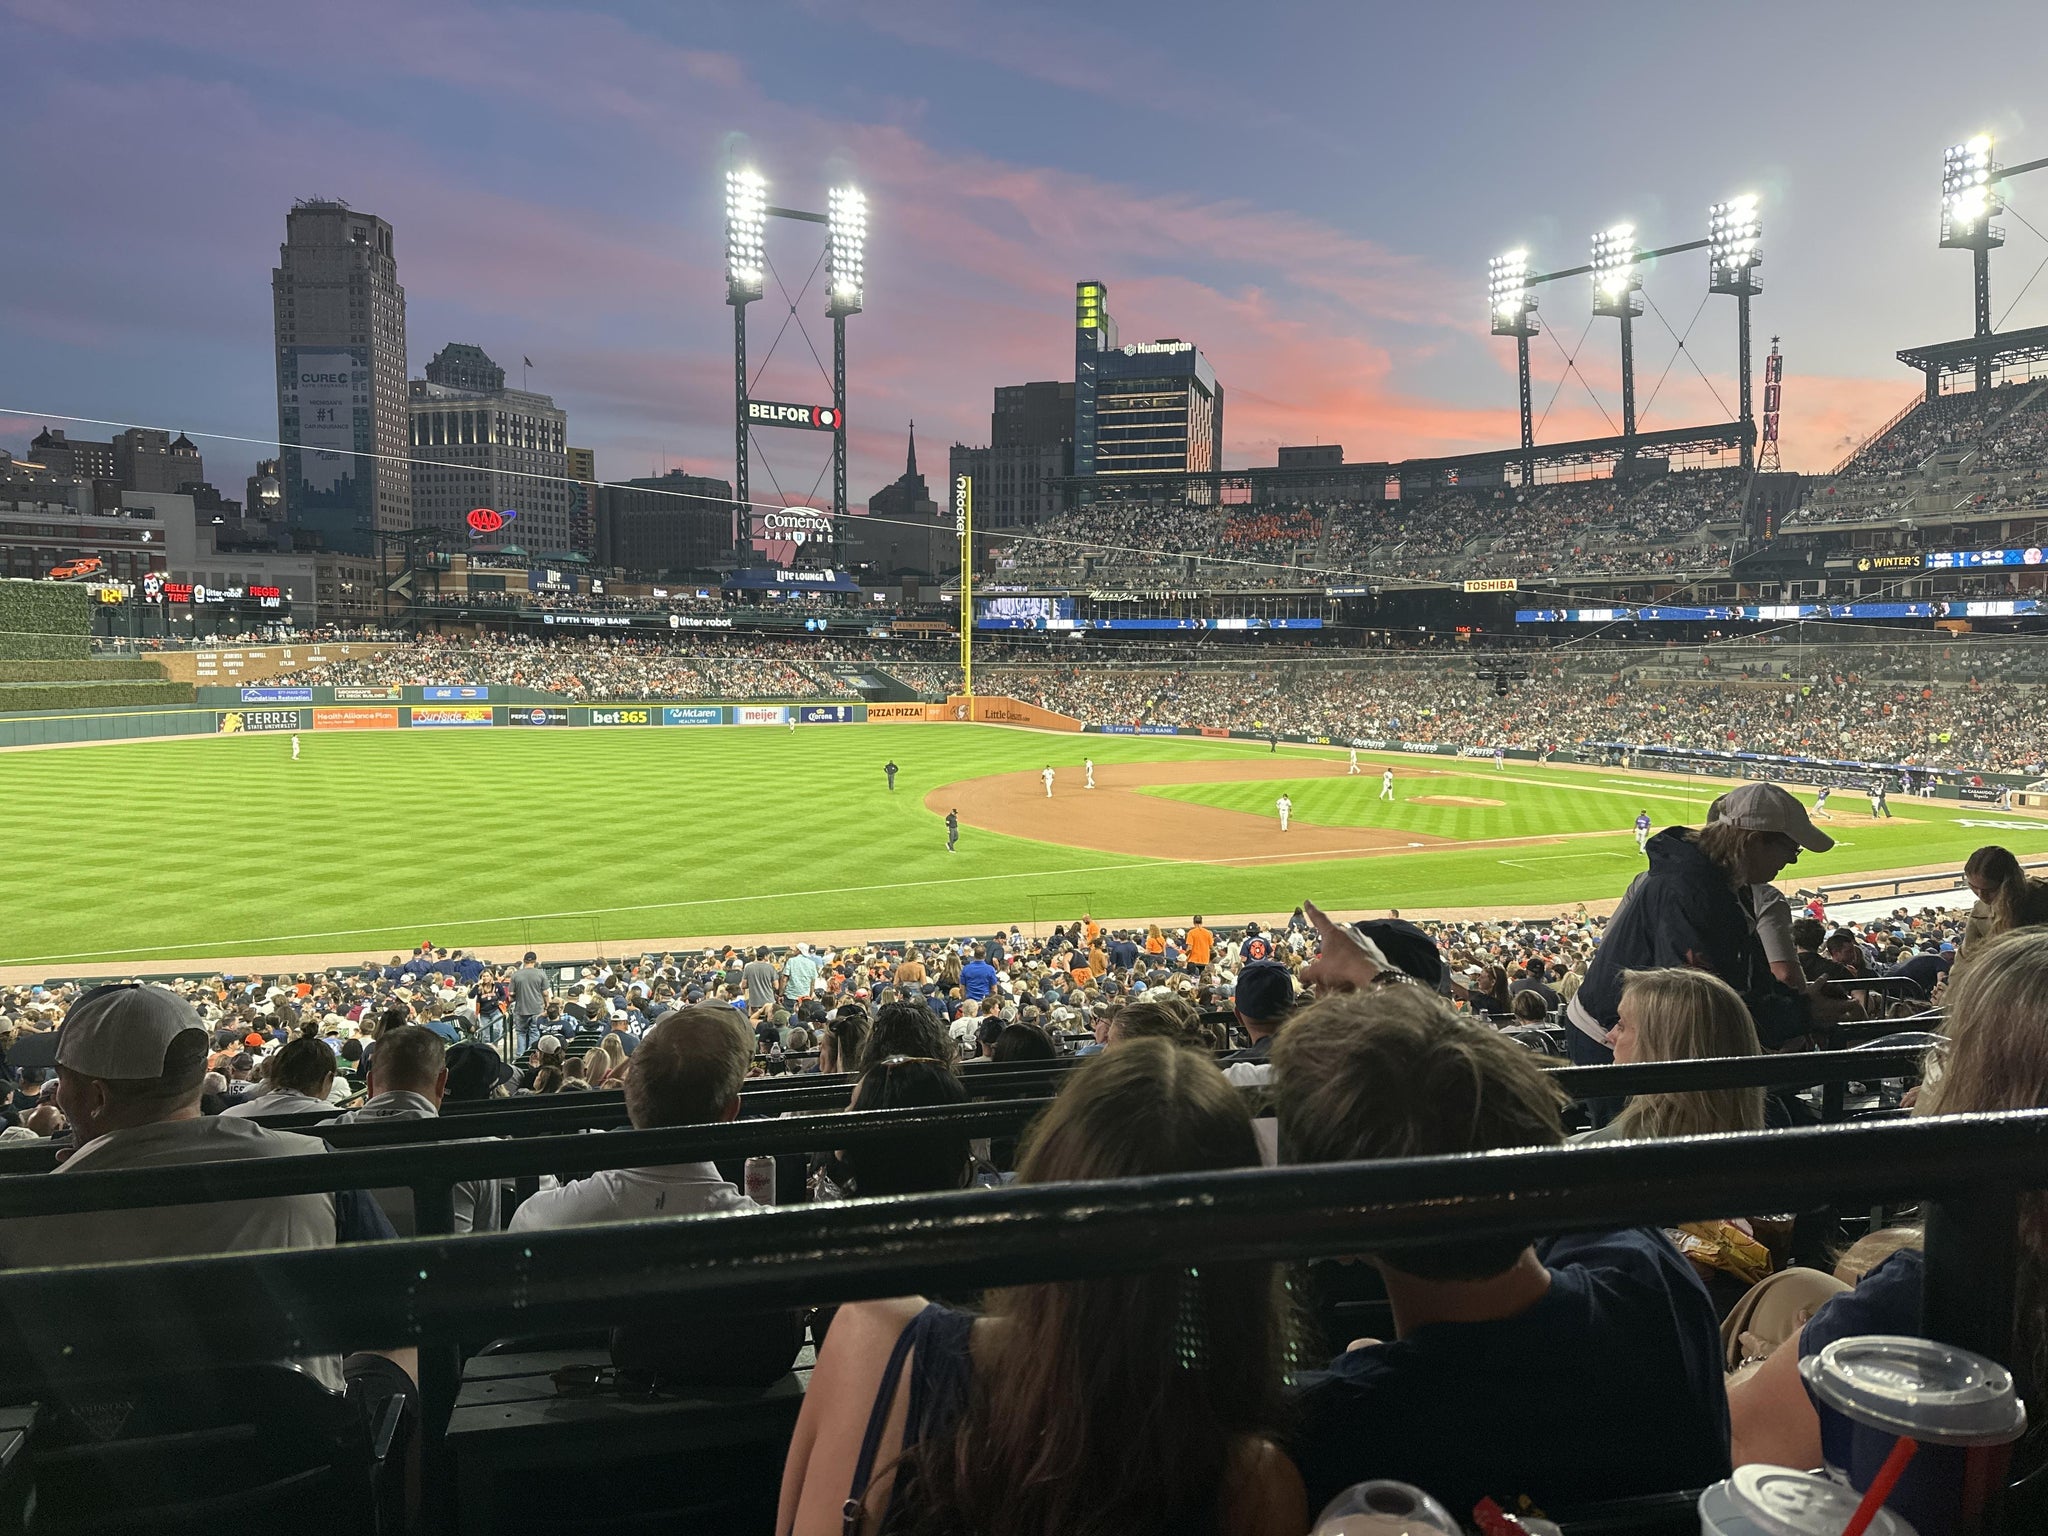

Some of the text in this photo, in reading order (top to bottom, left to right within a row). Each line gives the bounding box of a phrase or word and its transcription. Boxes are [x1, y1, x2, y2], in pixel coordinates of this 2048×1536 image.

[1138, 342, 1192, 355] Huntington
[301, 373, 337, 383] CURE
[317, 408, 334, 421] #1
[748, 403, 810, 422] BELFOR
[956, 490, 967, 536] Rocket
[470, 510, 501, 530] AAA
[764, 532, 834, 544] LANDING
[1873, 556, 1920, 568] WINTER'S
[547, 570, 562, 584] Lite
[776, 570, 824, 582] Lite LOUNGE
[164, 584, 193, 593] BELLE
[1466, 580, 1515, 590] TOSHIBA
[101, 589, 123, 602] 0:24
[250, 586, 280, 596] FIEGER
[1145, 591, 1198, 600] TIGER CLUB
[168, 593, 189, 602] TIRE
[260, 597, 280, 607] LAW
[556, 616, 580, 624] FIFTH
[581, 617, 606, 626] THIRD
[283, 649, 292, 658] 10
[317, 712, 343, 720] Health
[344, 712, 374, 720] Alliance
[418, 710, 462, 722] Surfside
[593, 711, 648, 724] bet365
[682, 709, 716, 718] McLaren
[745, 709, 778, 721] meijer
[808, 713, 833, 721] Corona
[868, 709, 894, 717] PIZZA!
[895, 708, 923, 716] PIZZA!
[985, 709, 1007, 720] Little
[247, 712, 297, 725] FERRIS
[264, 722, 297, 730] UNIVERSITY
[1306, 736, 1331, 745] bet365
[1352, 738, 1387, 748] Dunham's
[1402, 741, 1438, 752] Dunham's
